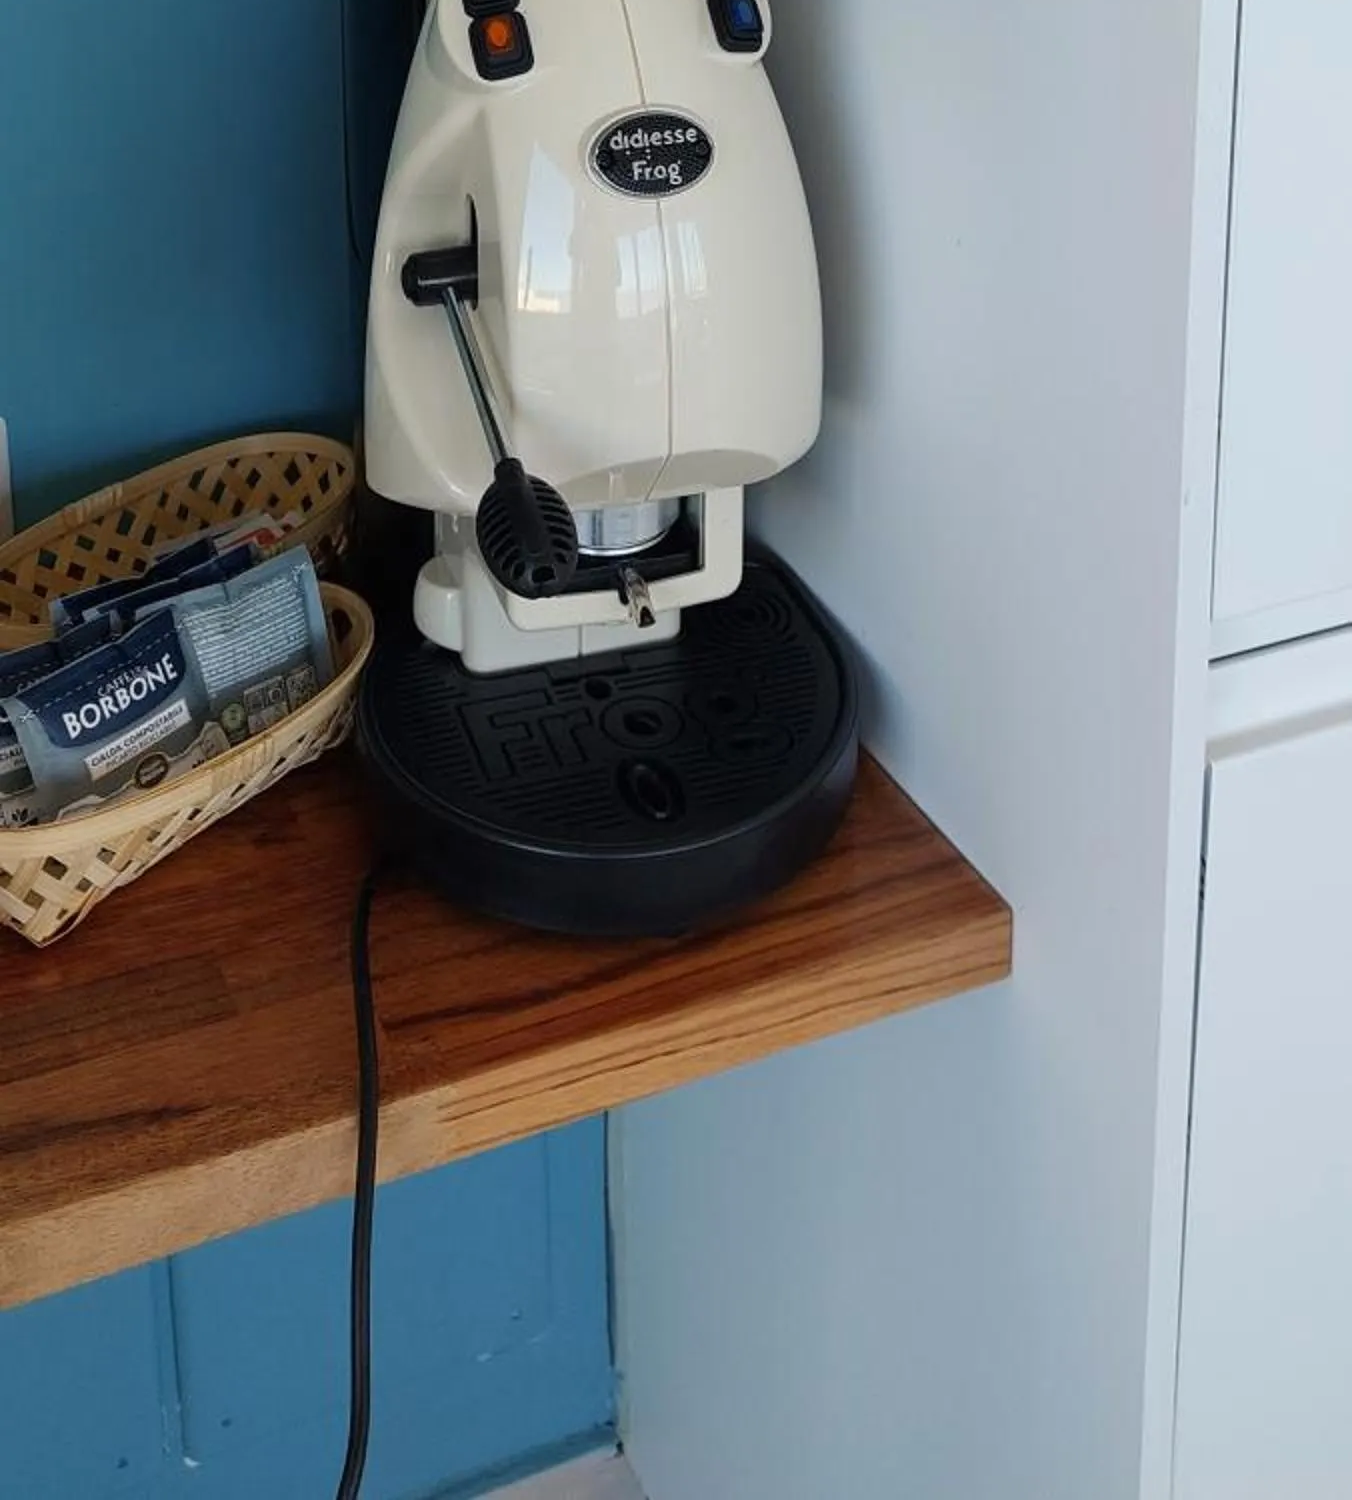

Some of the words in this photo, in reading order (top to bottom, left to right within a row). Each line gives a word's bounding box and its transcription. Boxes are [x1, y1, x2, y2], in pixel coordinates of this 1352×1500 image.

[609, 127, 699, 151] didiesse
[631, 160, 683, 185] Frog
[62, 653, 178, 740] BORBONE
[457, 672, 795, 782] Frog
